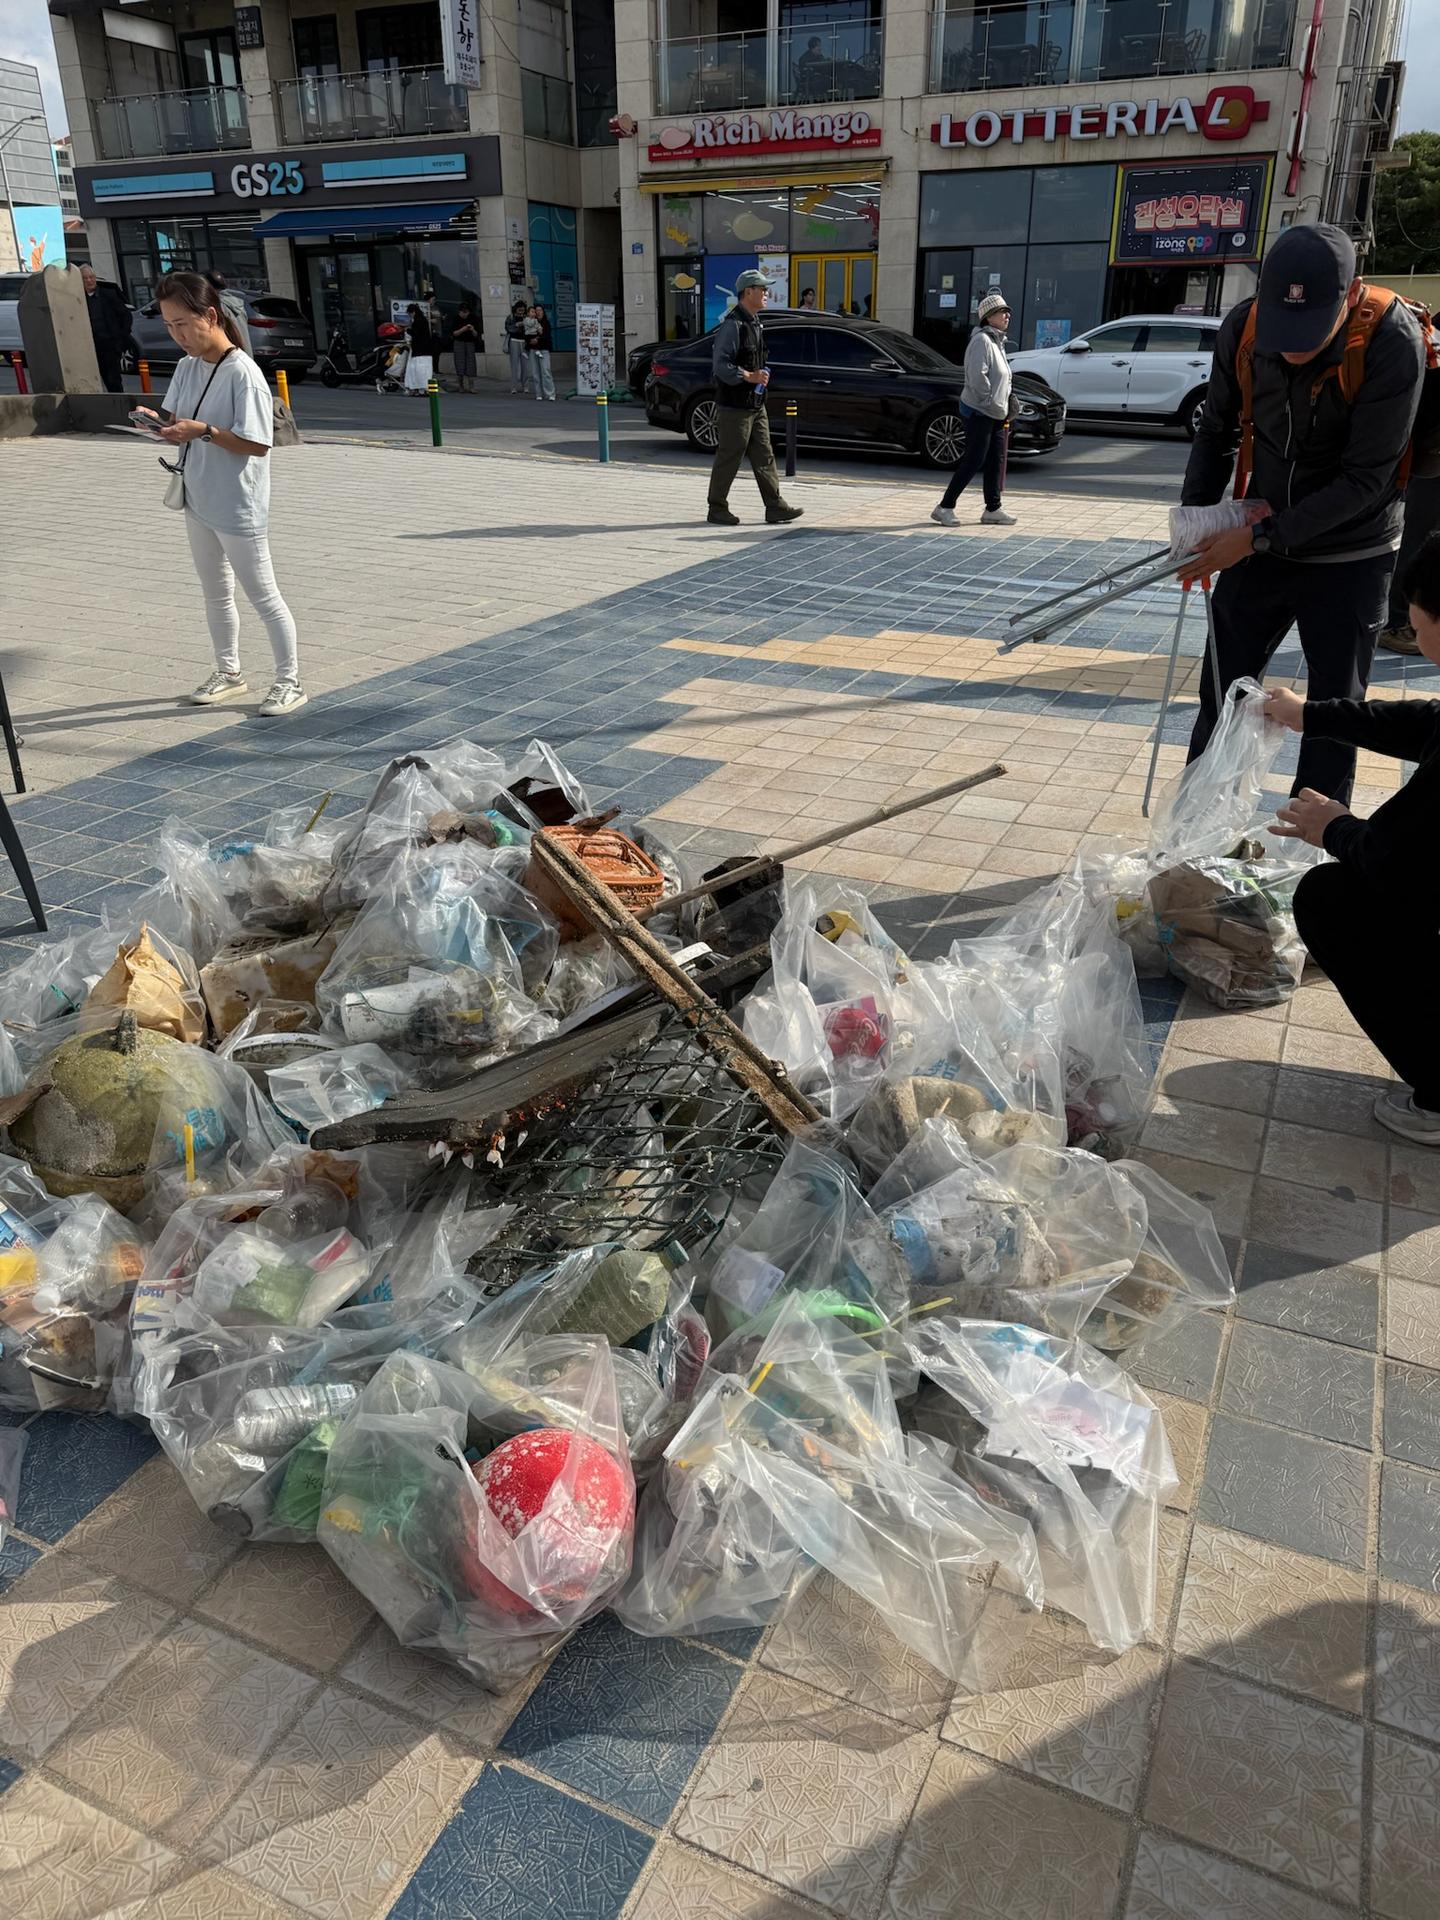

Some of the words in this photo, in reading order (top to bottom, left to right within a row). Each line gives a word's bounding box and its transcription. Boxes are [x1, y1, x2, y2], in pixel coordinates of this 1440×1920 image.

[693, 114, 761, 148] Rich
[769, 110, 871, 144] Mango
[940, 97, 1199, 149] LOTTERIA
[231, 160, 305, 199] GS25
[1134, 195, 1244, 231] 겜성오락실
[1155, 236, 1186, 249] izone
